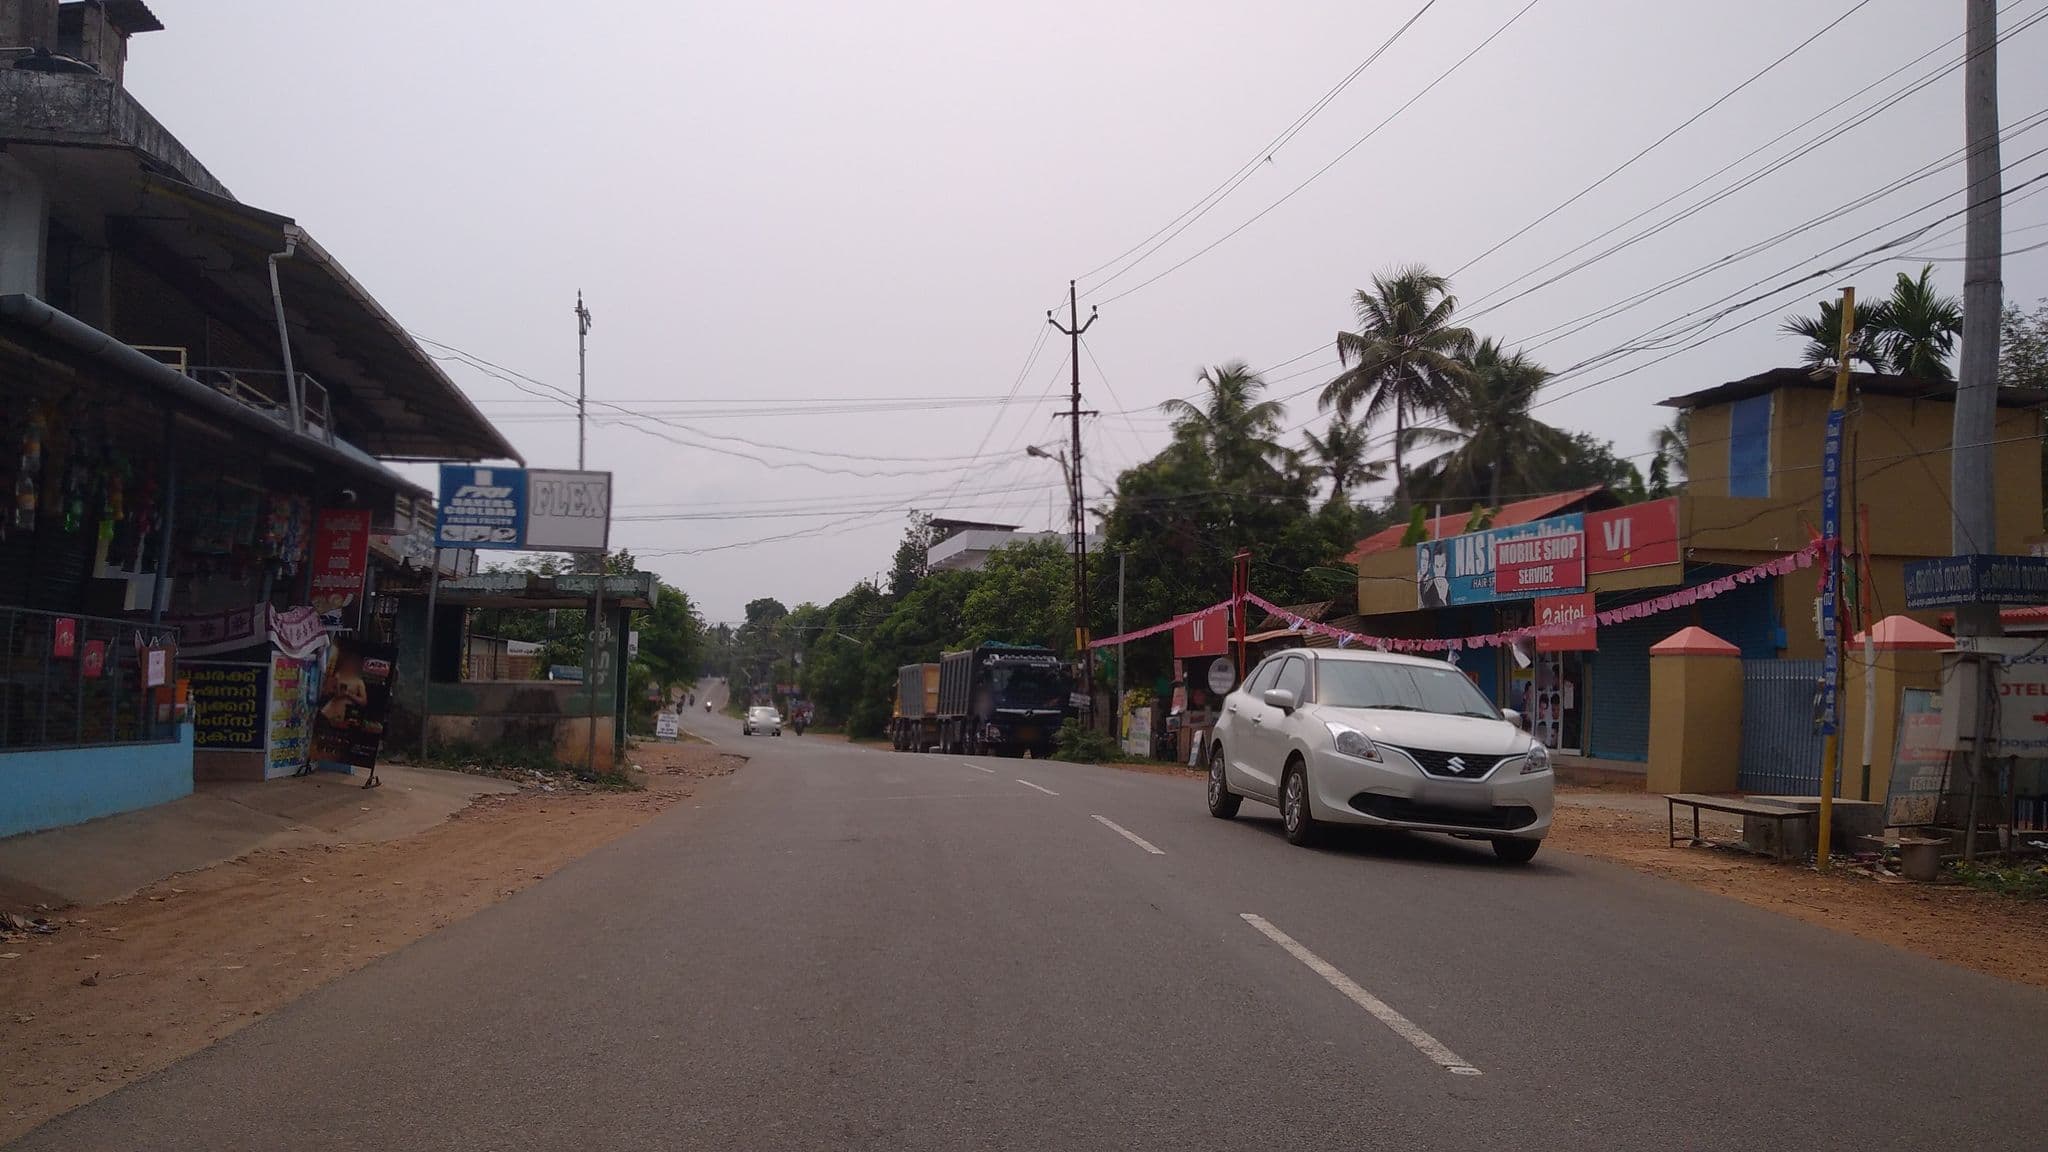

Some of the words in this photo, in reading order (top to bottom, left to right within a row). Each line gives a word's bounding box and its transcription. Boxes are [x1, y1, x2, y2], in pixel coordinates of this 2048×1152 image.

[533, 481, 607, 518] FLEX
[1455, 537, 1486, 578] NAS
[1499, 541, 1542, 565] MOBILE
[1543, 536, 1578, 561] SHOP
[1518, 565, 1555, 585] SERVICE
[1553, 603, 1586, 626] airtel
